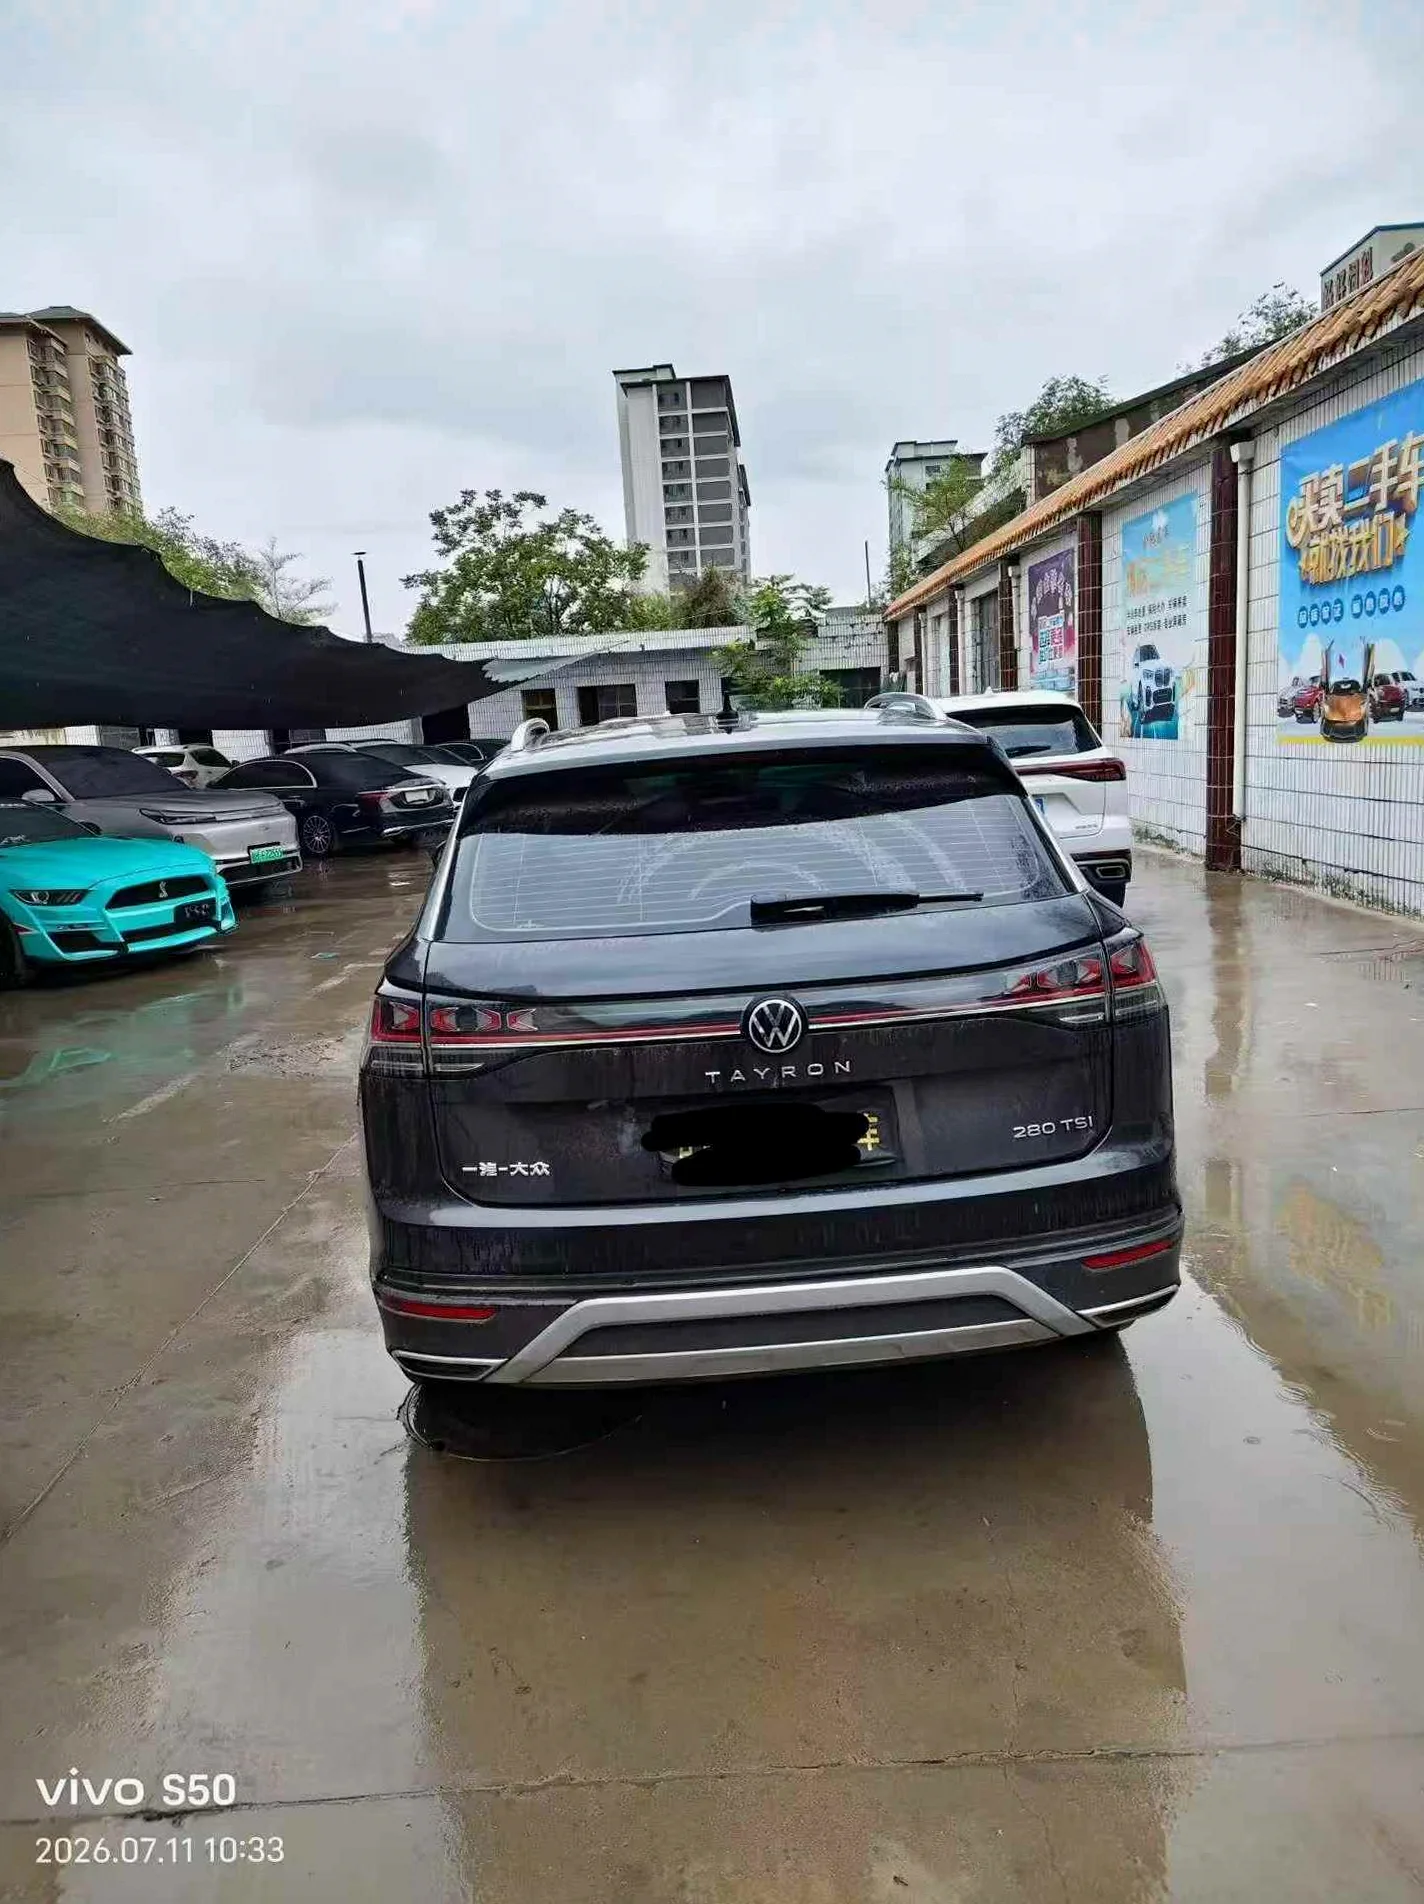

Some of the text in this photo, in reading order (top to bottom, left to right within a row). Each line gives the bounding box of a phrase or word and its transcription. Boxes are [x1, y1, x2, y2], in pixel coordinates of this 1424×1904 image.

[705, 1060, 852, 1083] TAYRON
[1013, 1115, 1094, 1139] 280 TSI
